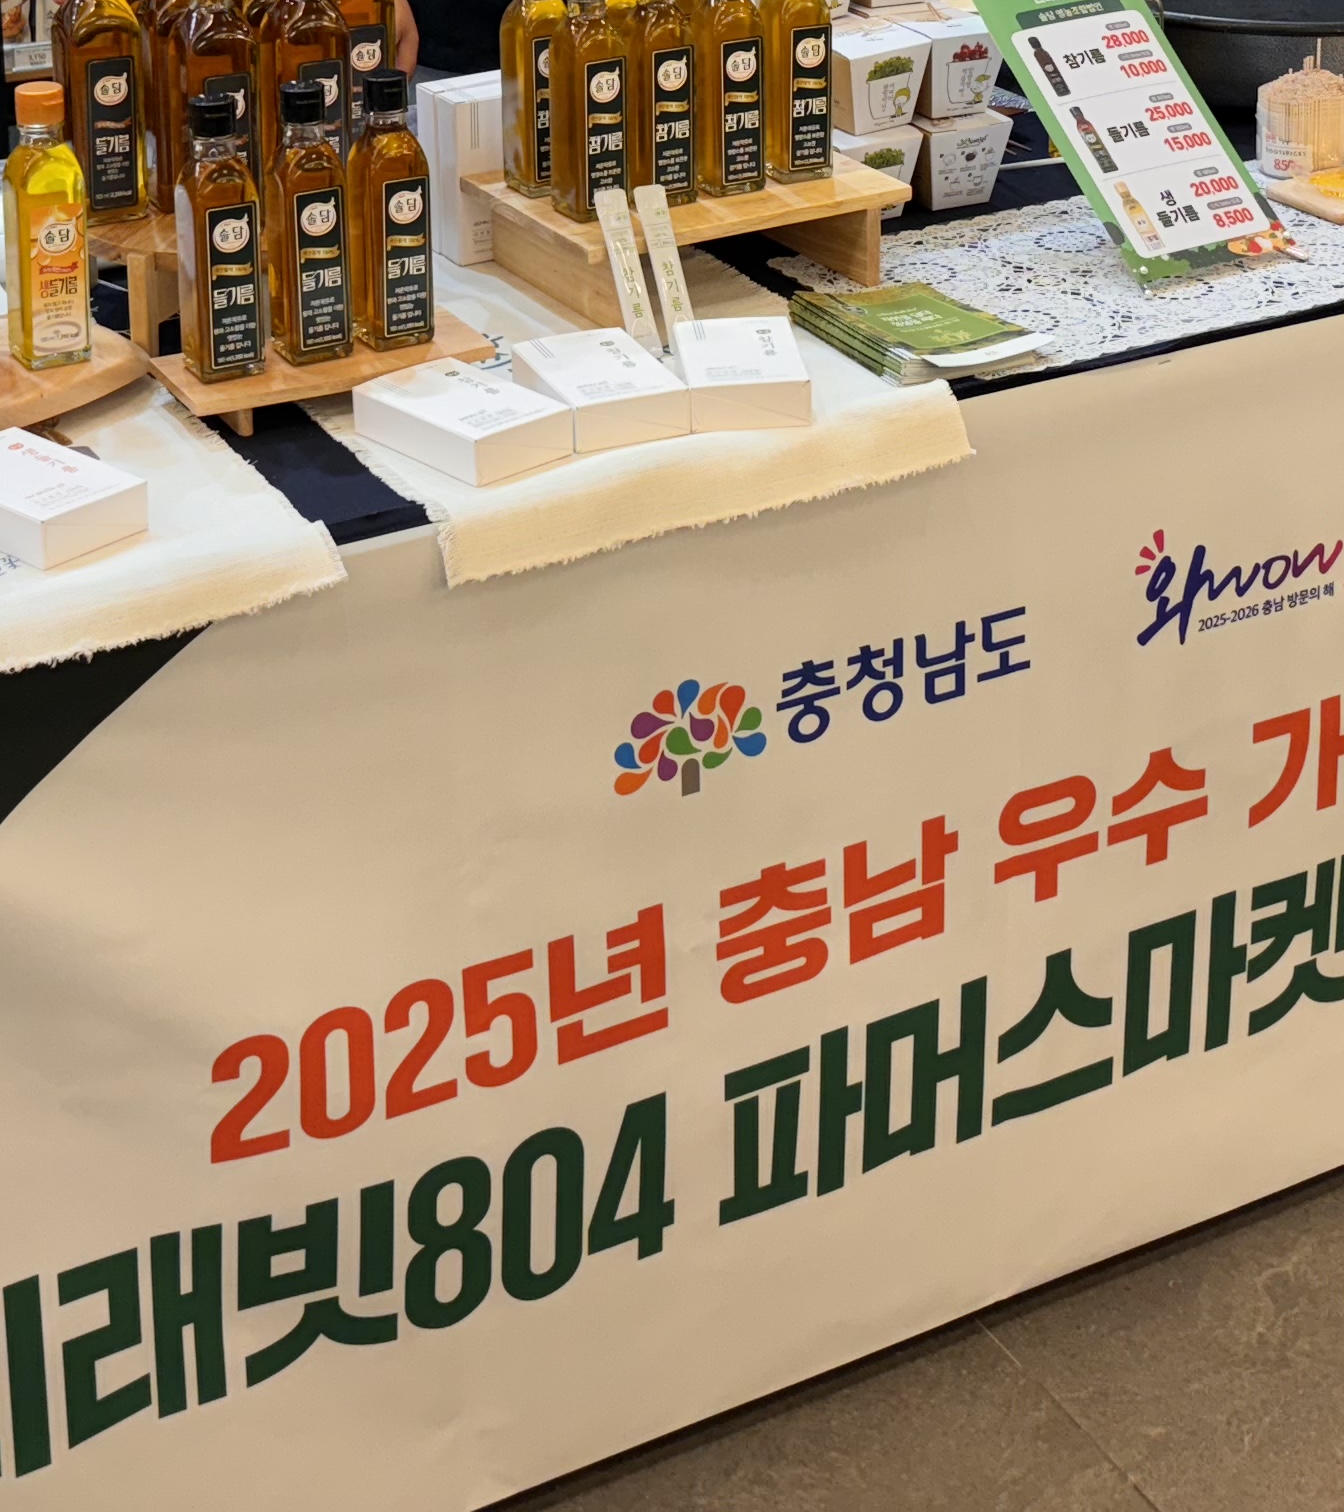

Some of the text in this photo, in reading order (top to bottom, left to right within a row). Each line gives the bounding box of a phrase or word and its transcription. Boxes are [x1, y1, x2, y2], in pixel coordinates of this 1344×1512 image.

[1102, 30, 1150, 50] 28,000
[1063, 48, 1106, 70] 참기름
[1120, 59, 1168, 79] 10,000
[793, 96, 827, 118] 참기름
[1145, 101, 1193, 123] 25,000
[656, 119, 690, 143] 참기름
[724, 109, 760, 133] 참기름
[1106, 120, 1150, 144] 들기름
[95, 134, 131, 156] 들기름
[589, 131, 623, 155] 참기름
[1164, 132, 1212, 153] 15,000
[1159, 189, 1178, 207] 생
[1190, 176, 1239, 198] 20,000
[1156, 204, 1201, 229] 들기름
[1213, 207, 1254, 229] 8,500
[387, 254, 426, 279] 들기름
[39, 276, 78, 299] 생들기름
[302, 266, 342, 292] 들기름
[213, 284, 254, 309] 들기름
[1196, 580, 1336, 633] 2025-2026 충남 방문의 해
[776, 606, 1031, 744] 충청남도
[210, 904, 668, 1164] 2025년
[712, 817, 958, 1002] 충남
[993, 745, 1209, 902] 우수
